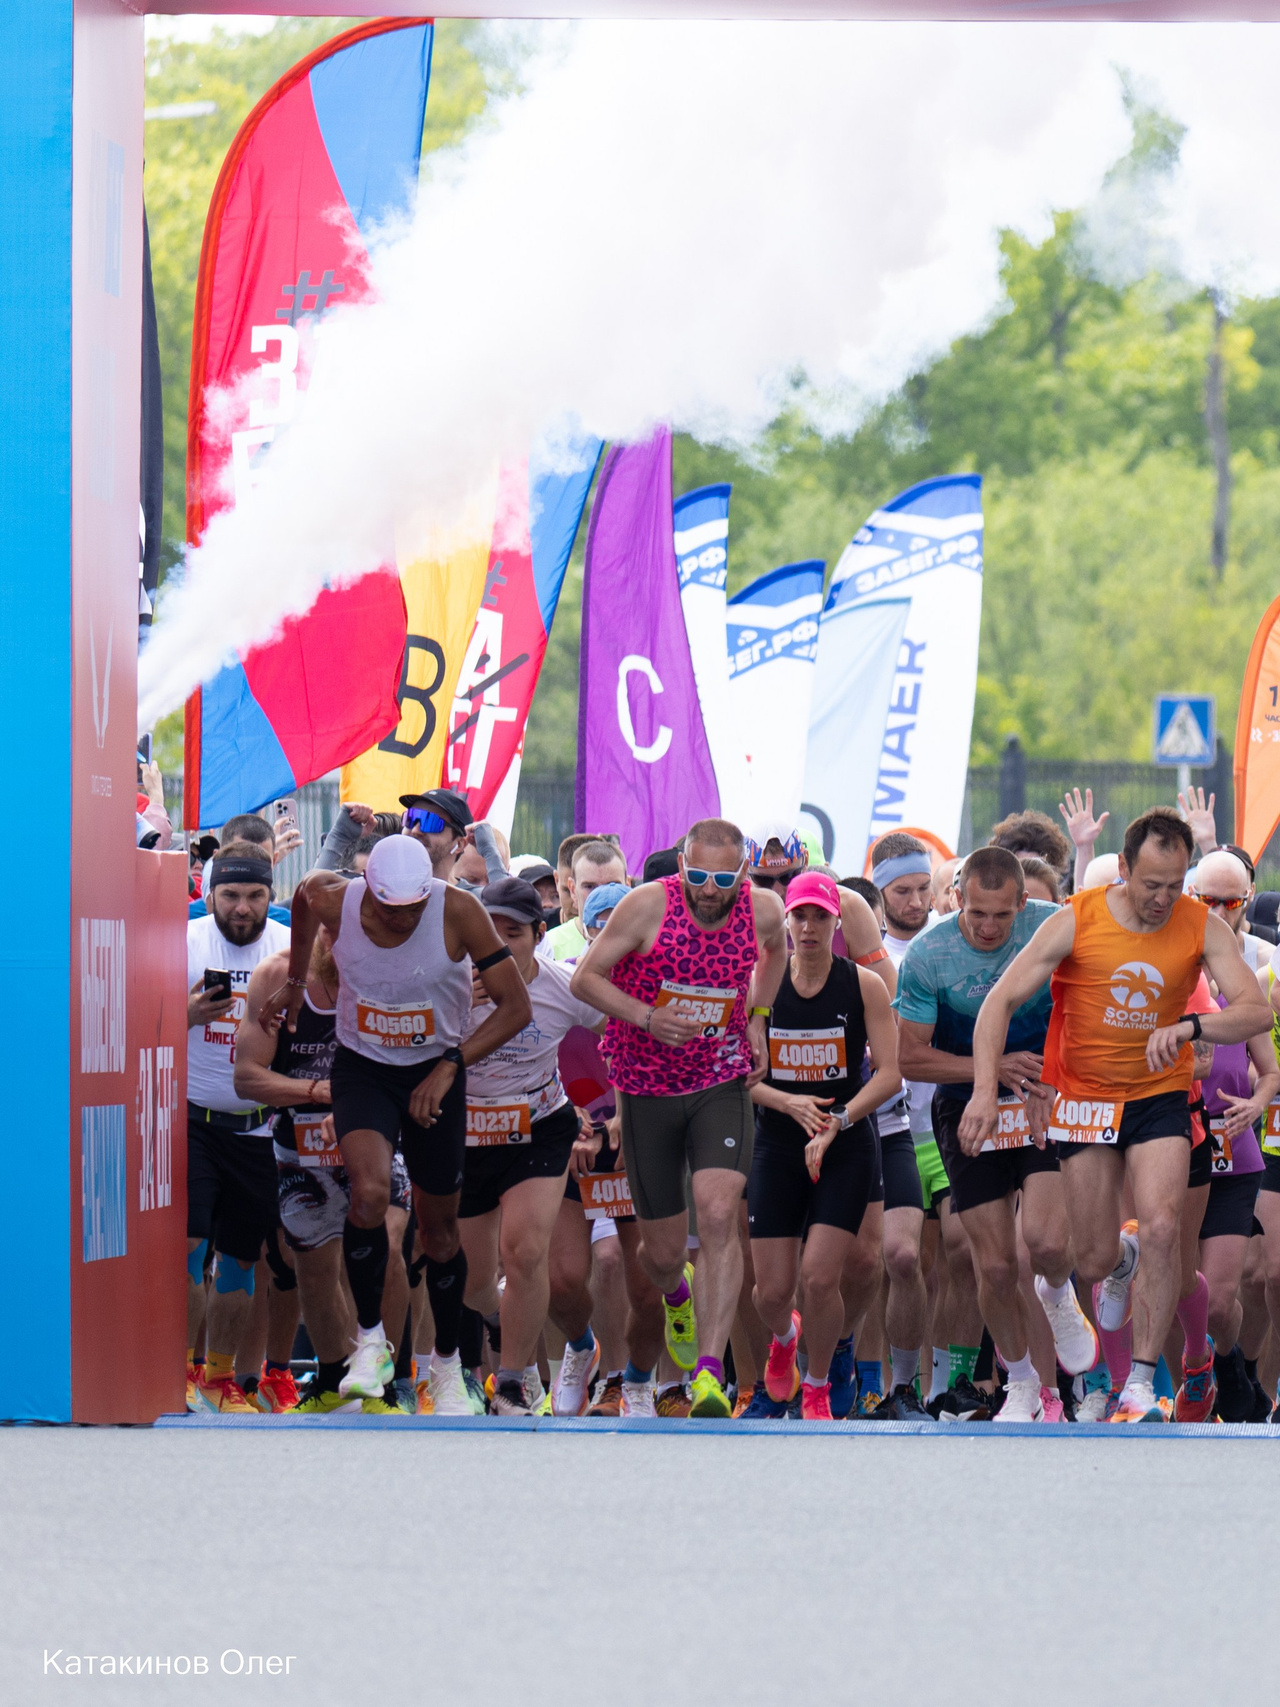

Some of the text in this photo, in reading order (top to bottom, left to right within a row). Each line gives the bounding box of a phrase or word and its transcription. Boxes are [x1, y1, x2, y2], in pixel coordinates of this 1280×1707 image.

[855, 535, 978, 594] ЗАБЕГ.РФ
[1269, 685, 1279, 708] 1
[365, 1012, 427, 1035] 40560
[1103, 1016, 1156, 1030] MARATHON
[1105, 1007, 1158, 1023] SOCHI
[291, 1043, 325, 1055] KEEP
[778, 1043, 838, 1066] 40050
[1056, 1099, 1115, 1127] 40075
[1103, 1128, 1113, 1139] A
